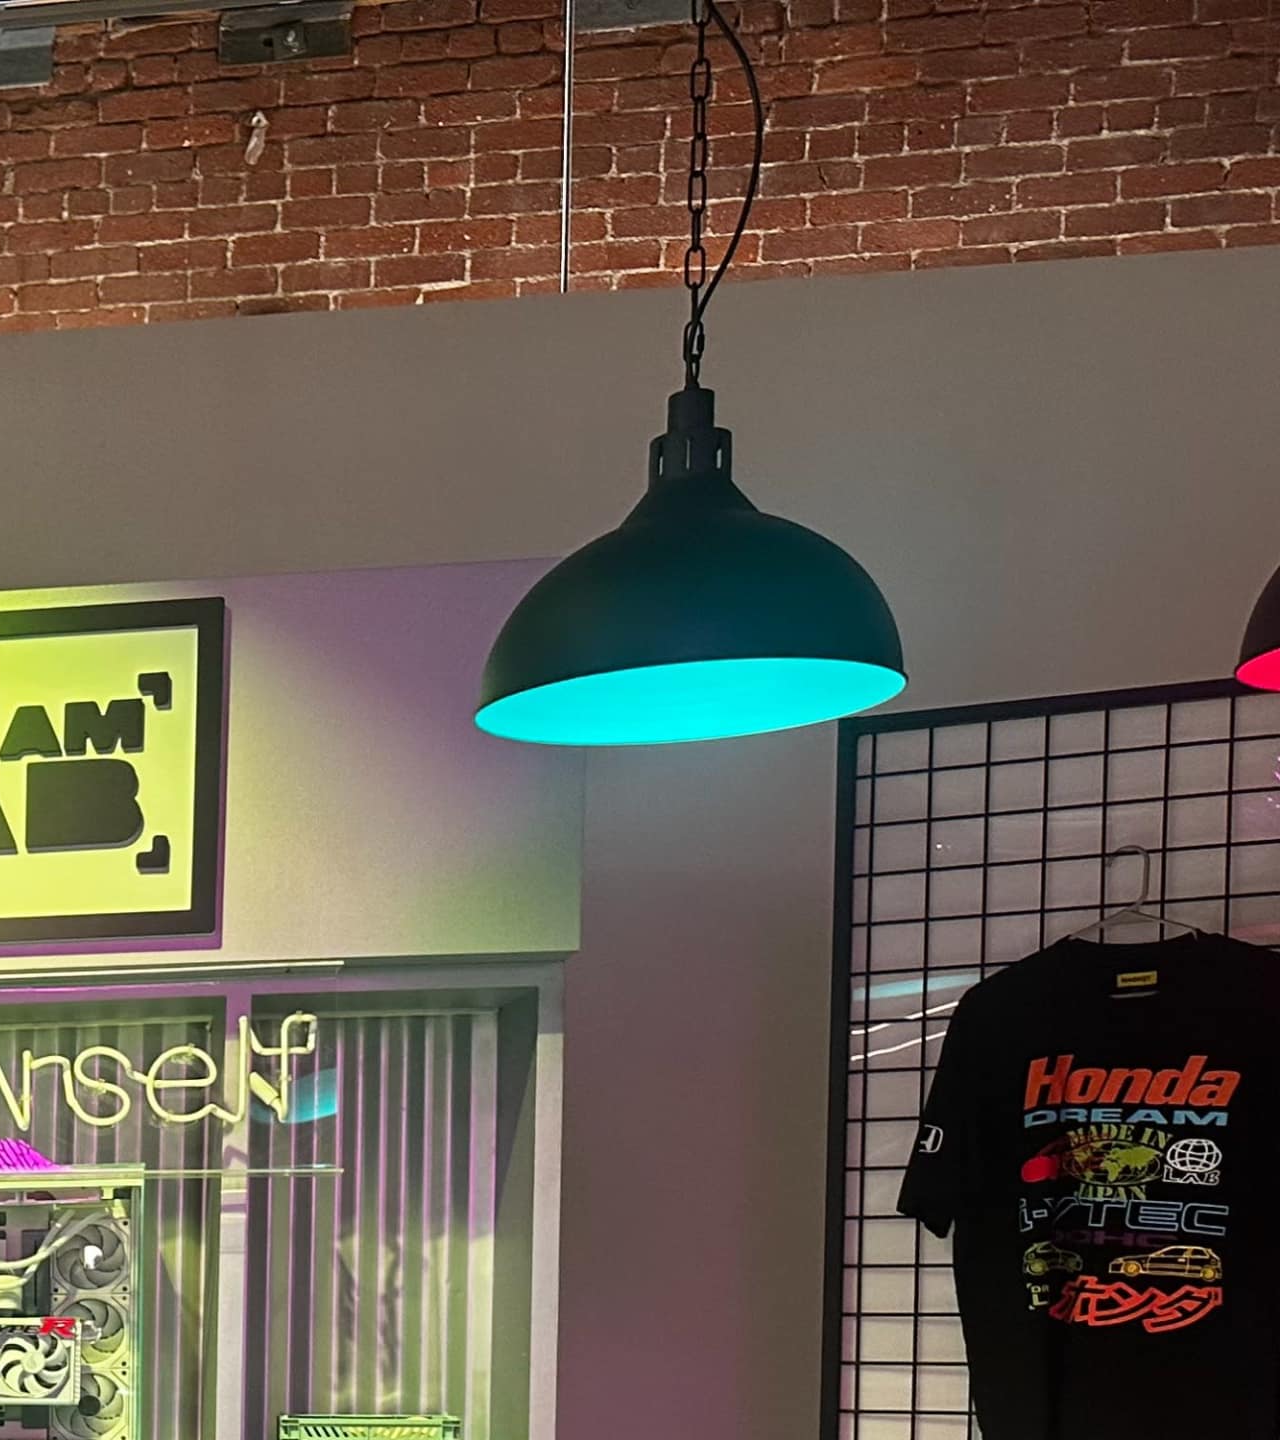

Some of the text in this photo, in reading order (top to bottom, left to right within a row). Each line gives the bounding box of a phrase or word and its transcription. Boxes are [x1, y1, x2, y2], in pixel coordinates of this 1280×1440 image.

[1023, 1054, 1241, 1111] Honda
[1024, 1108, 1229, 1129] DREAM
[1066, 1124, 1174, 1150] MADE IN
[1162, 1165, 1221, 1186] LAB
